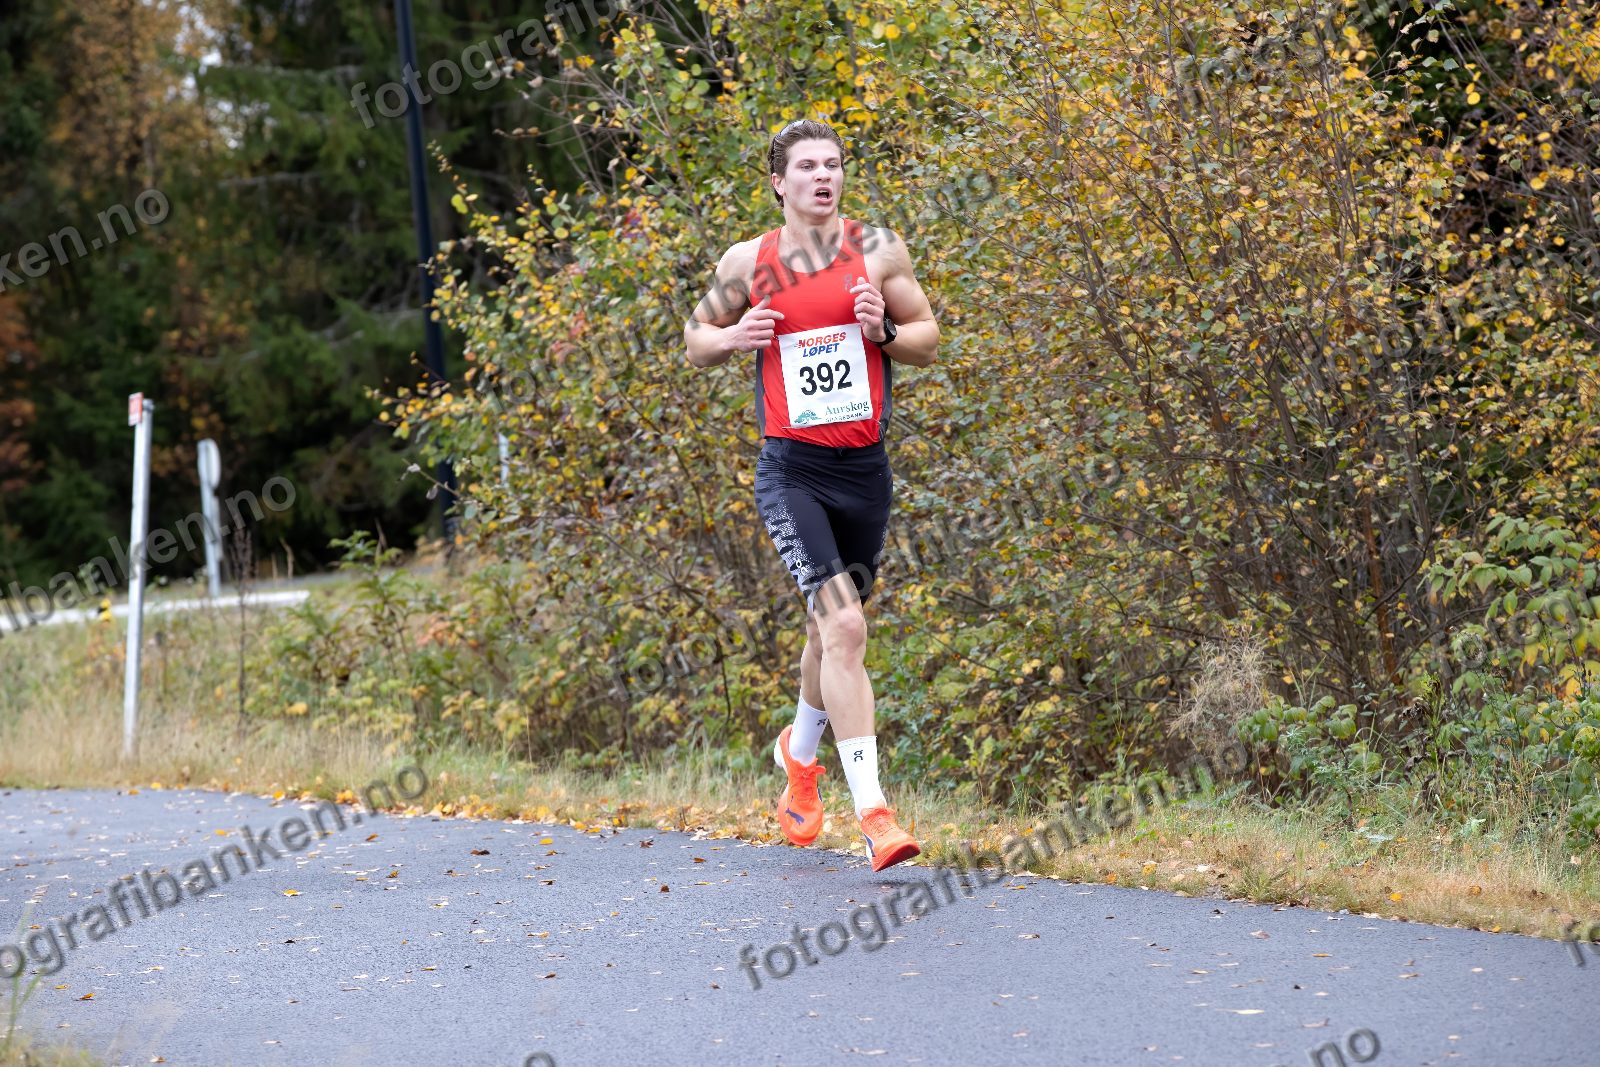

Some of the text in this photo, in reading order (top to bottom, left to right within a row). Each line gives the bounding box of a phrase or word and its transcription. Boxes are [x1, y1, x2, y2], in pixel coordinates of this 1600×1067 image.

[797, 331, 846, 348] NORGES
[802, 342, 840, 358] LØPET
[799, 359, 853, 396] 392
[825, 401, 870, 416] Aurskog
